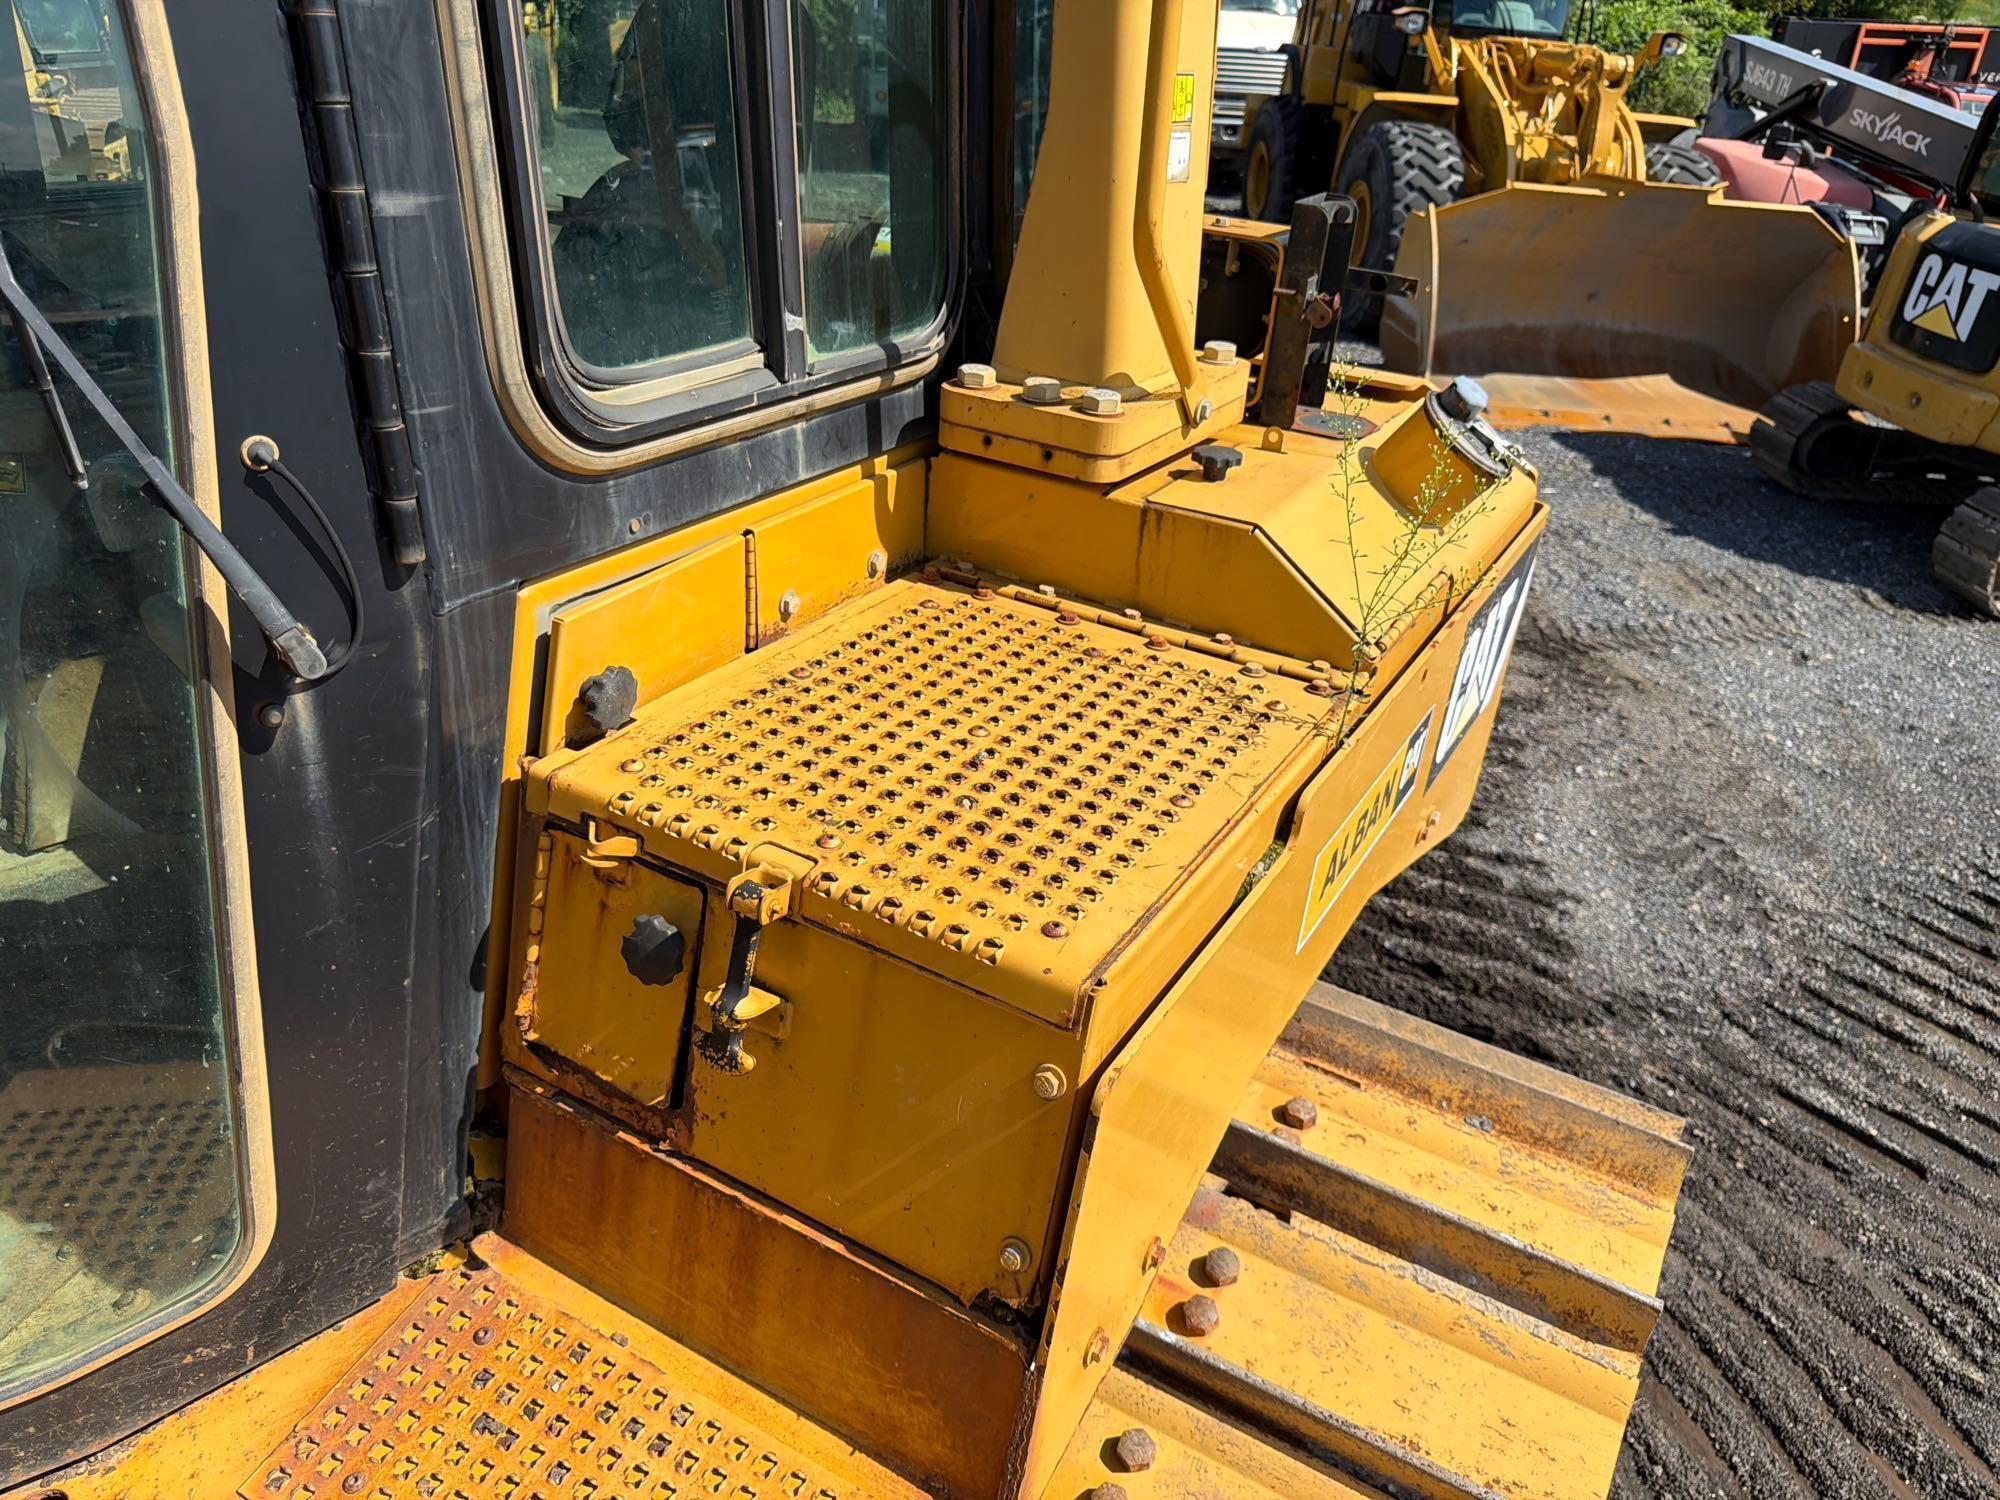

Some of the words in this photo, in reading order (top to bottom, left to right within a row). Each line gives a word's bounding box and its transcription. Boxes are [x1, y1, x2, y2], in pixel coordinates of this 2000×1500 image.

[1850, 109, 1932, 156] SKYJACK
[1903, 253, 2000, 343] CAT
[1436, 577, 1520, 764] CAT
[1318, 768, 1398, 903] ALBAN
